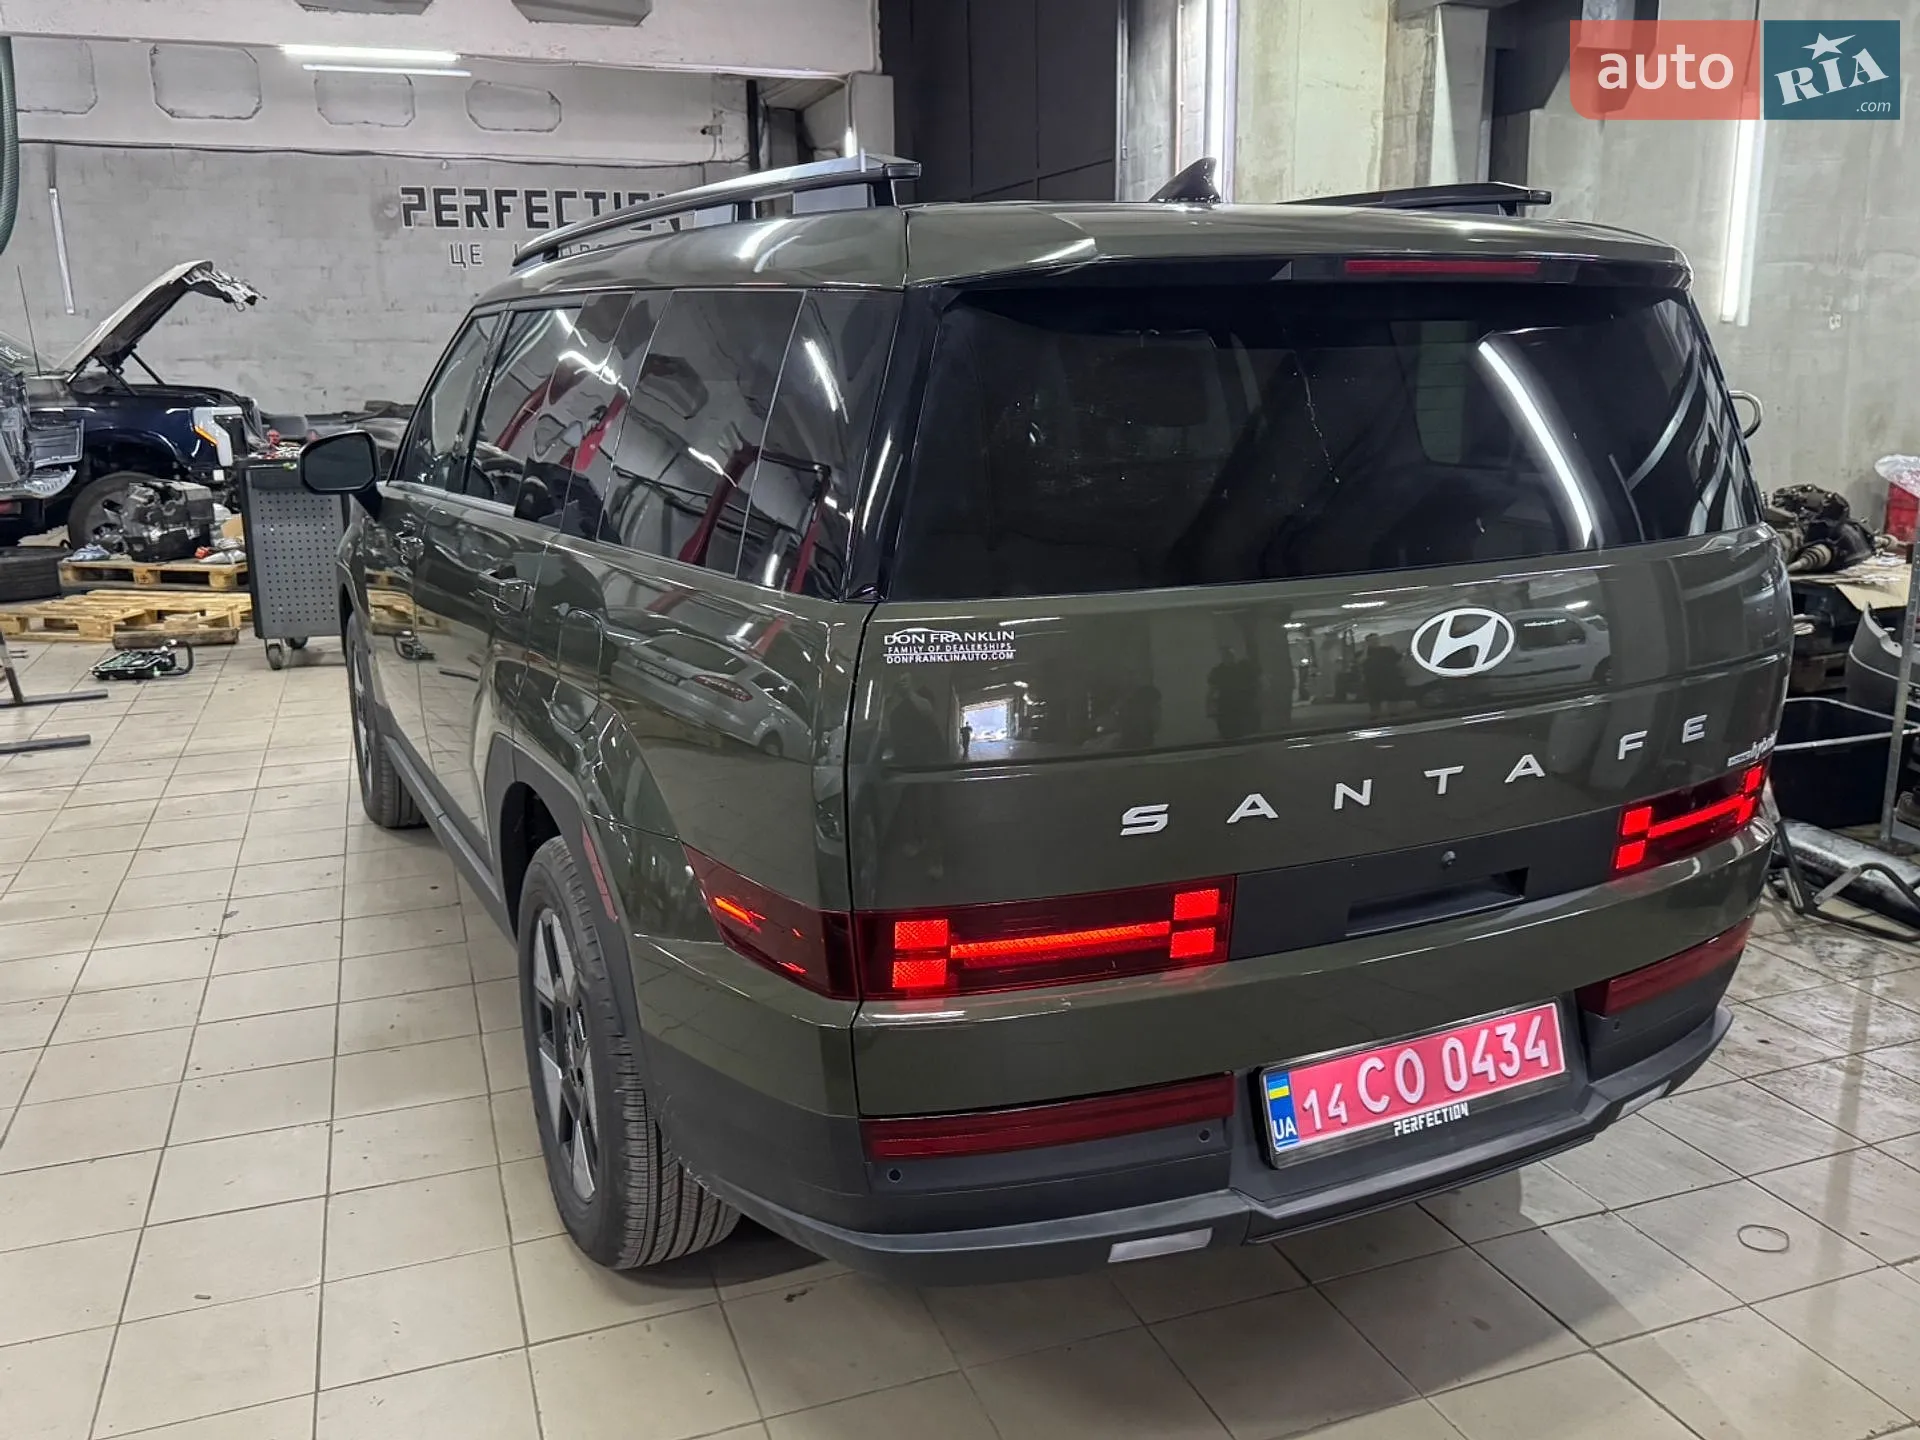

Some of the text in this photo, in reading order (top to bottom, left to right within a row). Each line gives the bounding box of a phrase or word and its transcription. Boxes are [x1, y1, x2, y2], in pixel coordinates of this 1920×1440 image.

[450, 244, 483, 268] ЦЕ
[884, 631, 1015, 645] DON FRANKLIN
[888, 643, 1012, 655] FAMILY OF DEALERSHIPS
[886, 652, 1014, 664] DONFRANKLINAUTO.COM
[1120, 714, 1708, 836] SANTA FE
[1441, 1015, 1550, 1092] 0434
[1273, 1119, 1298, 1140] UA
[1393, 1102, 1469, 1137] PERFECTION
